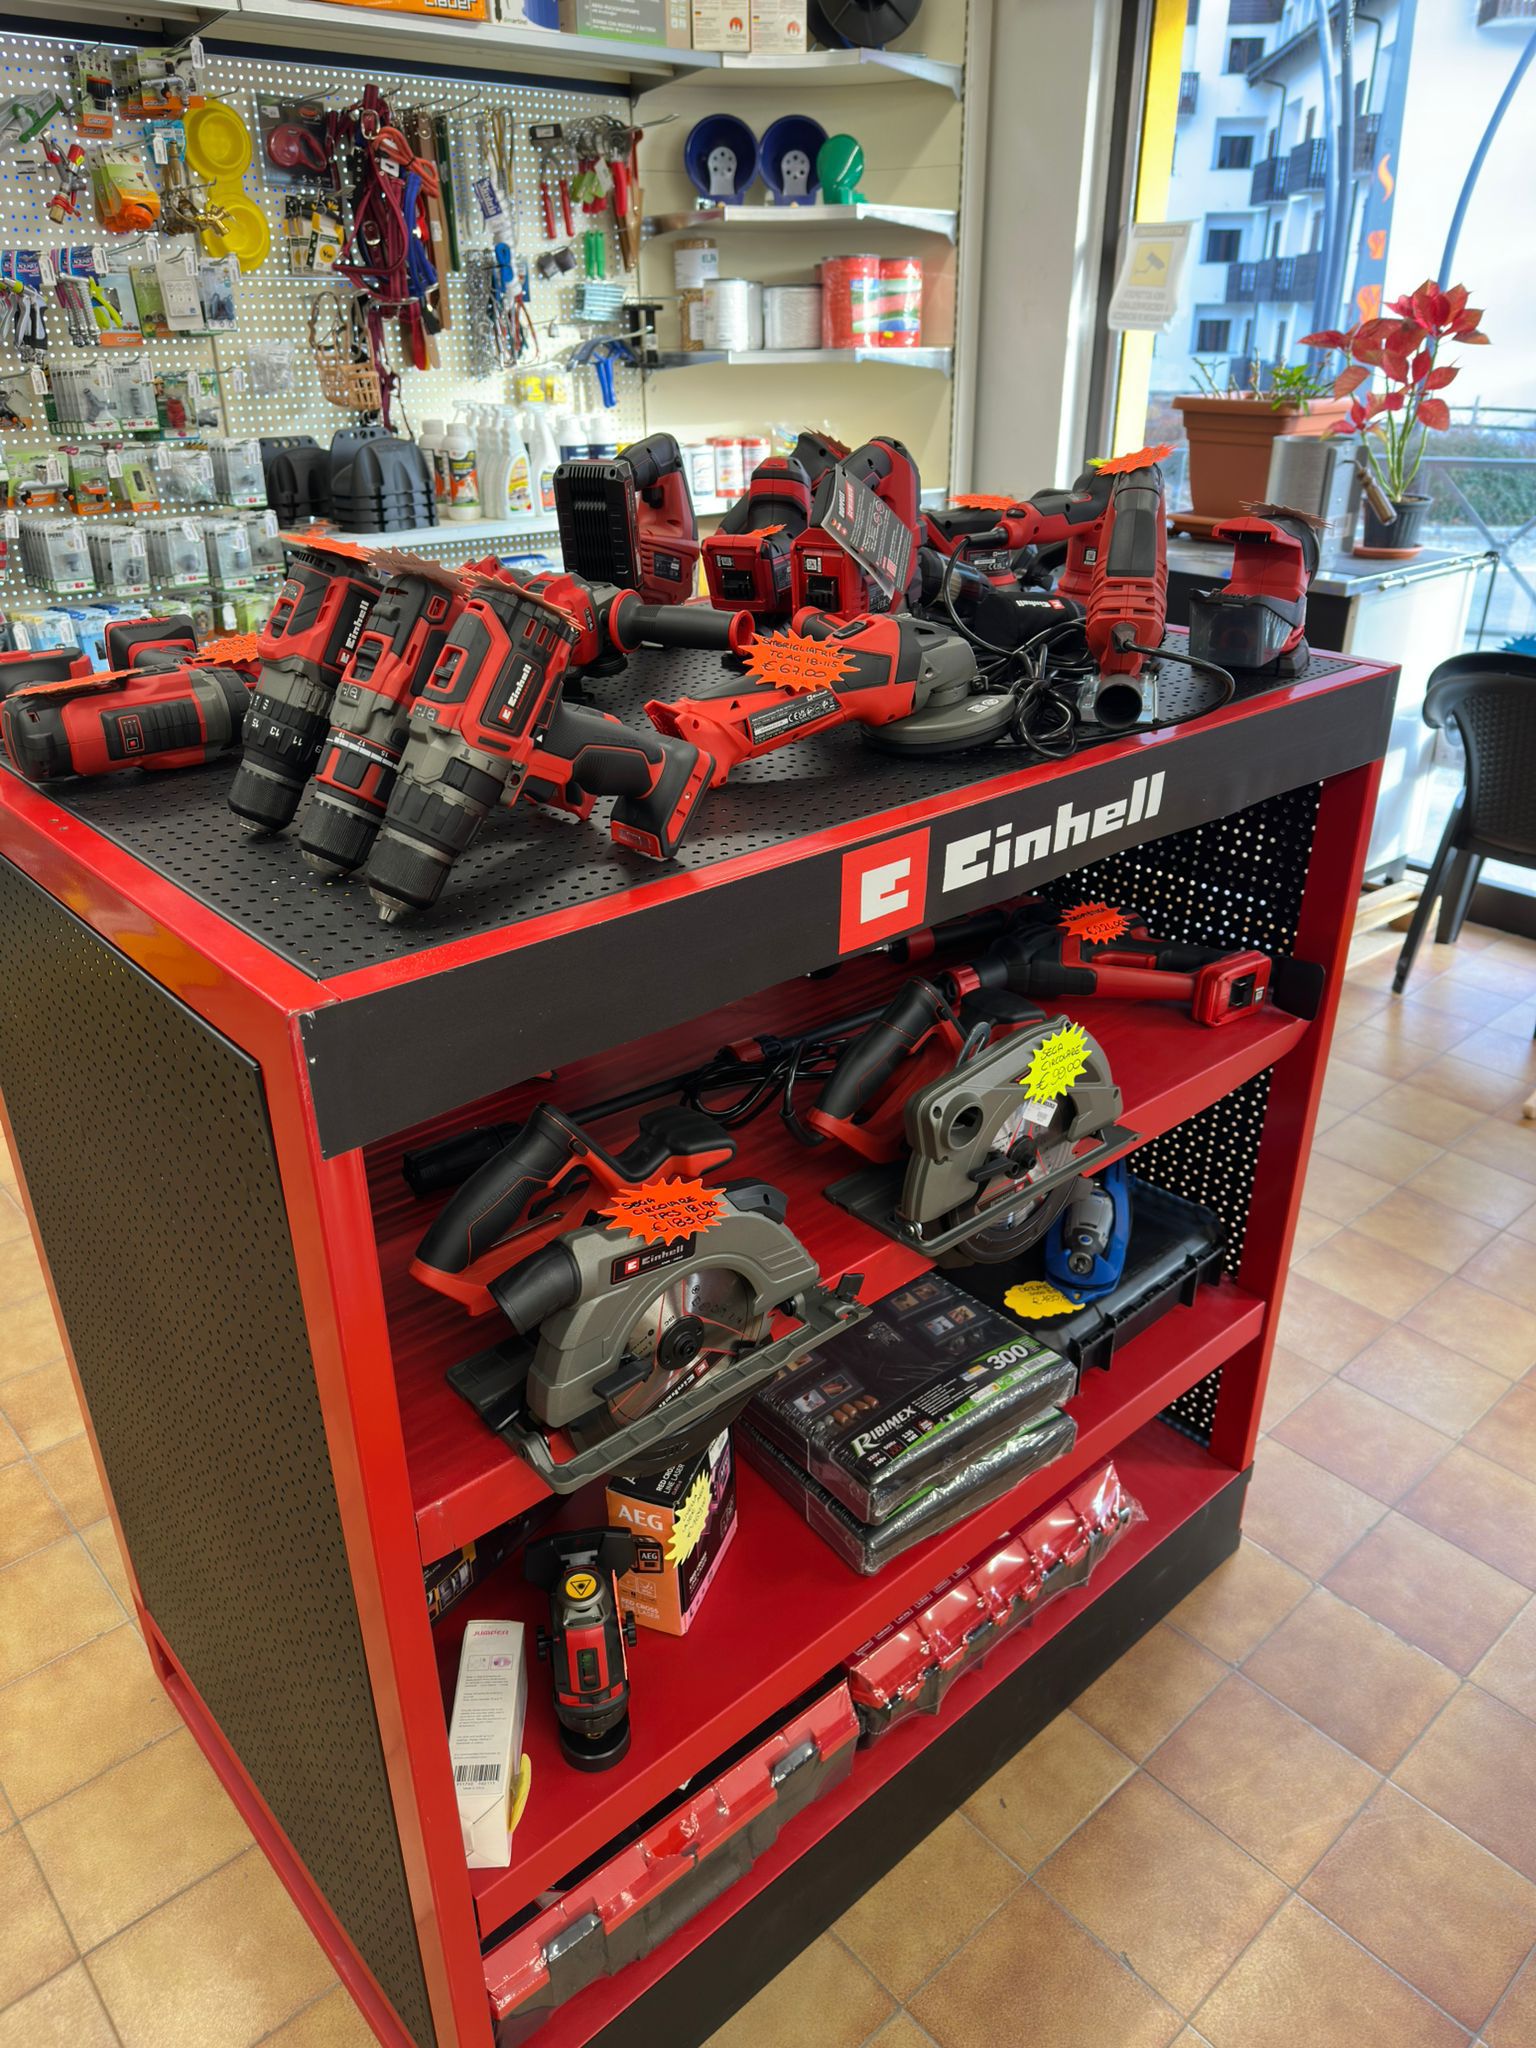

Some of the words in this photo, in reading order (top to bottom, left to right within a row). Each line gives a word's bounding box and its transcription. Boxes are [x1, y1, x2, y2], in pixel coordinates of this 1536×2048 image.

[1016, 600, 1051, 608] Einhell
[345, 600, 370, 649] Einhell
[507, 664, 532, 707] Einhell
[269, 726, 280, 737] 13
[292, 736, 303, 746] 11
[943, 771, 1165, 893] Einhell
[641, 1244, 684, 1265] Einhell
[987, 1344, 1029, 1371] 300
[851, 1405, 916, 1458] RIBIMEX
[656, 1479, 667, 1491] RED
[663, 1481, 676, 1494] LINE
[671, 1463, 686, 1481] LASER
[618, 1503, 664, 1532] AEG
[641, 1552, 658, 1560] AEG
